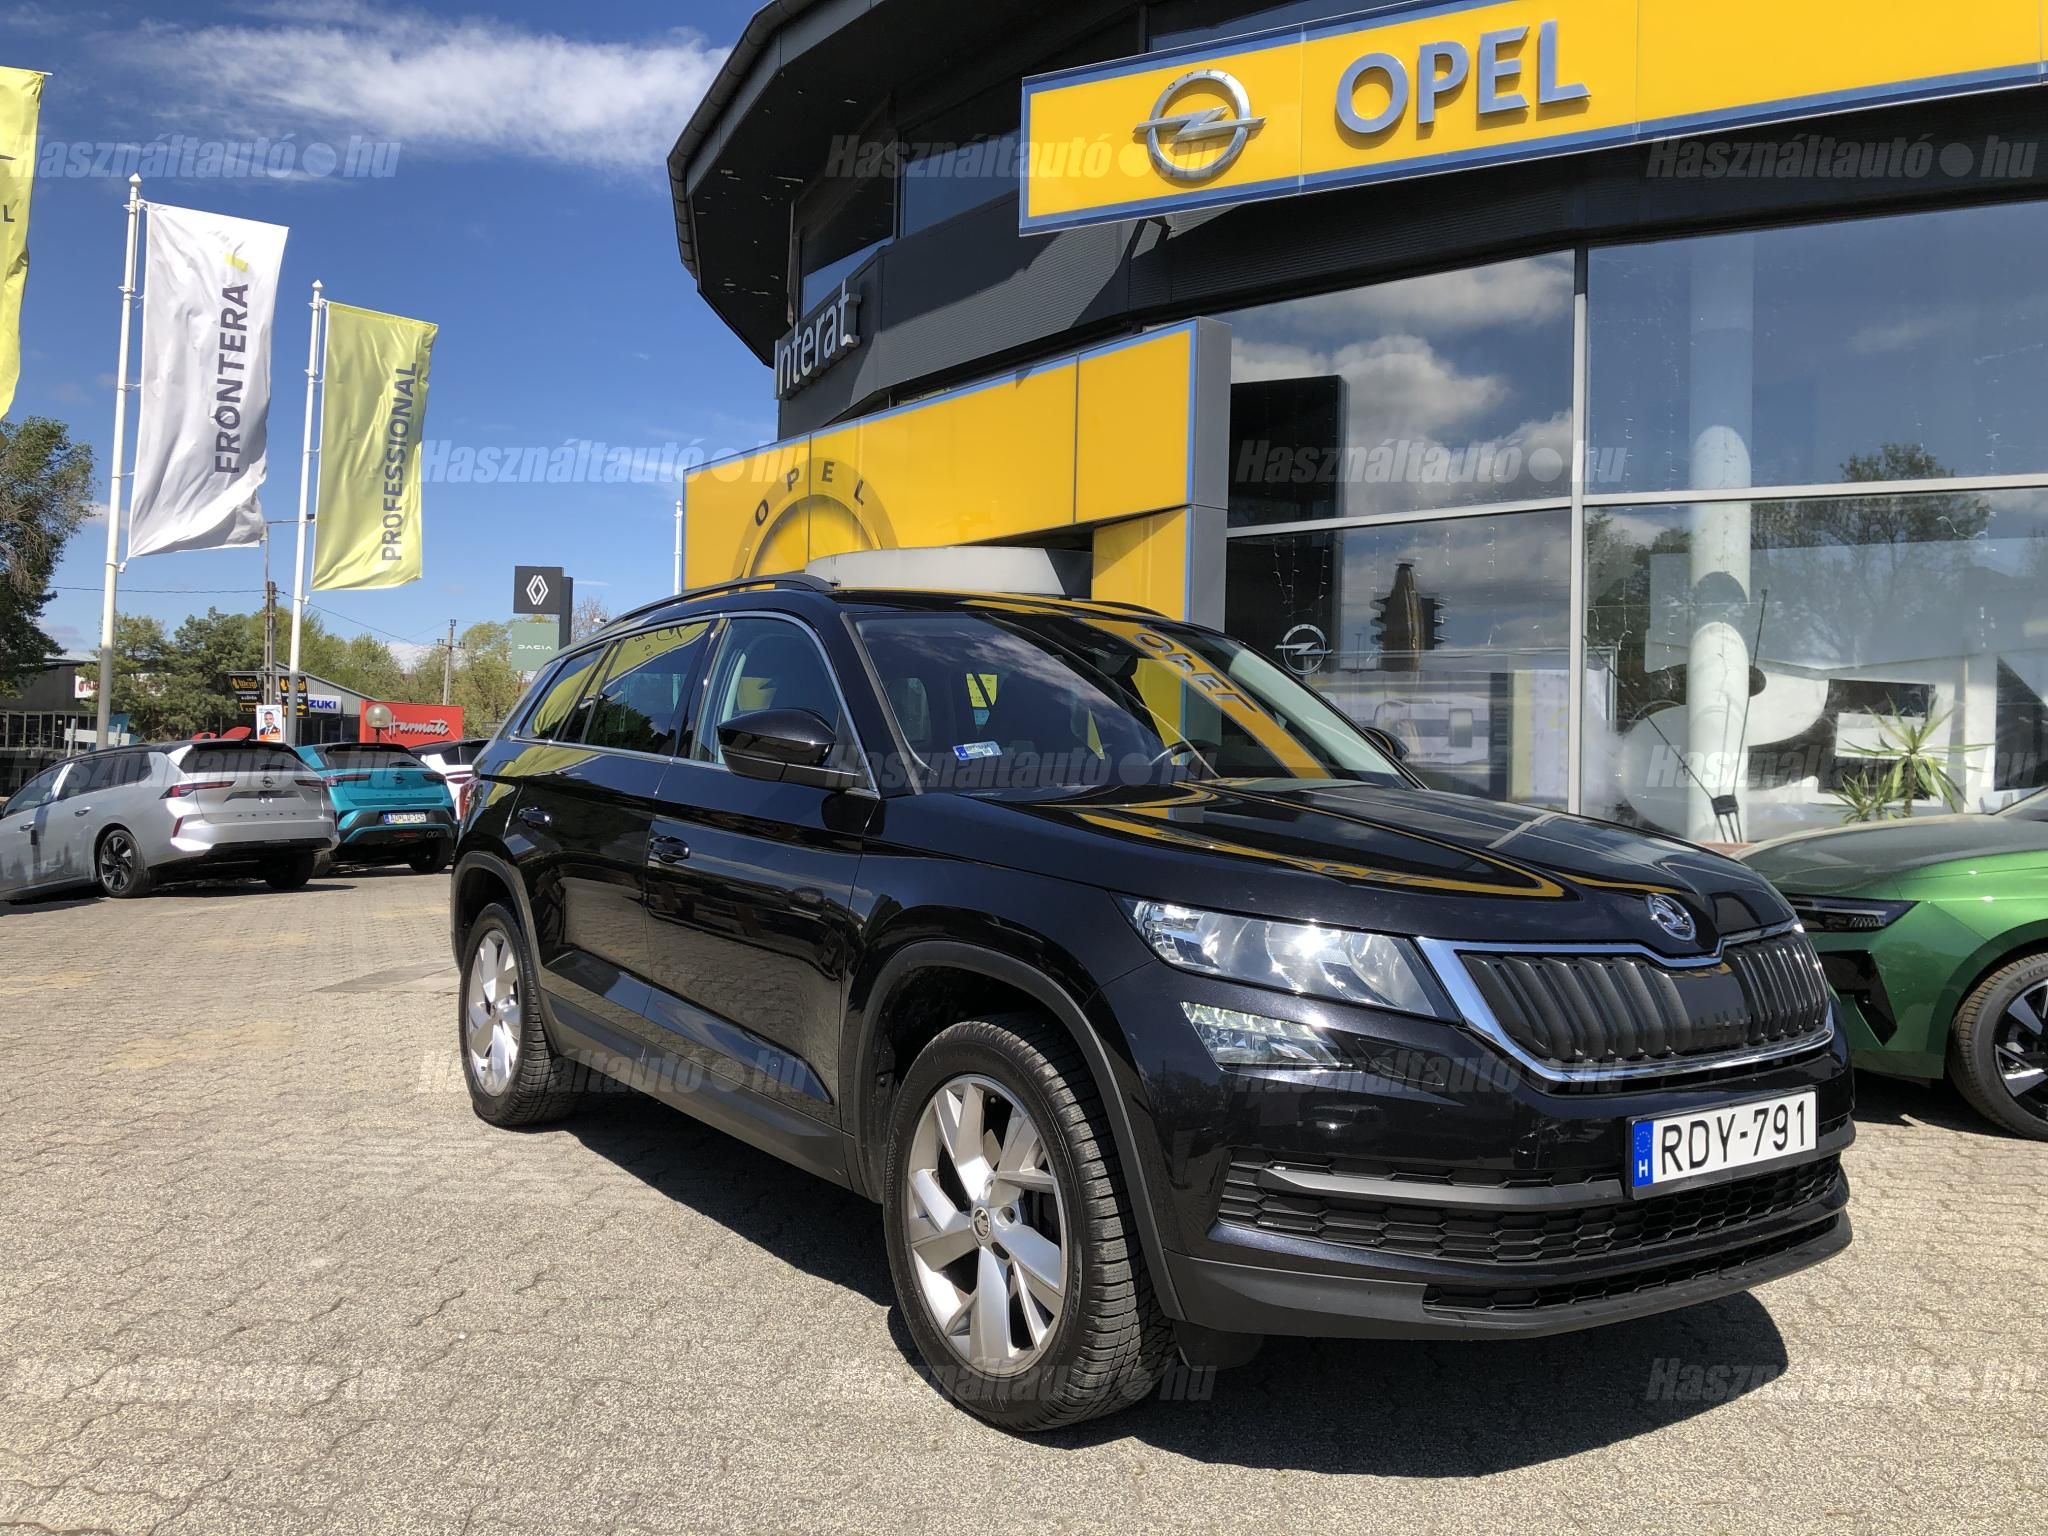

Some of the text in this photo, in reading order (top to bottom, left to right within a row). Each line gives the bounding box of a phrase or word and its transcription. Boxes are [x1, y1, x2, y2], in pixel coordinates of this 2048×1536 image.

[1167, 68, 1229, 91] OPEL
[1336, 18, 1592, 134] OPEL
[775, 278, 852, 400] Interat
[214, 283, 249, 474] FRONTERA
[381, 362, 417, 561] PROFESSIONAL
[754, 460, 865, 527] OPEL
[308, 699, 337, 710] ZUKI
[1638, 1158, 1649, 1178] H
[1661, 1100, 1805, 1176] RDY-791
